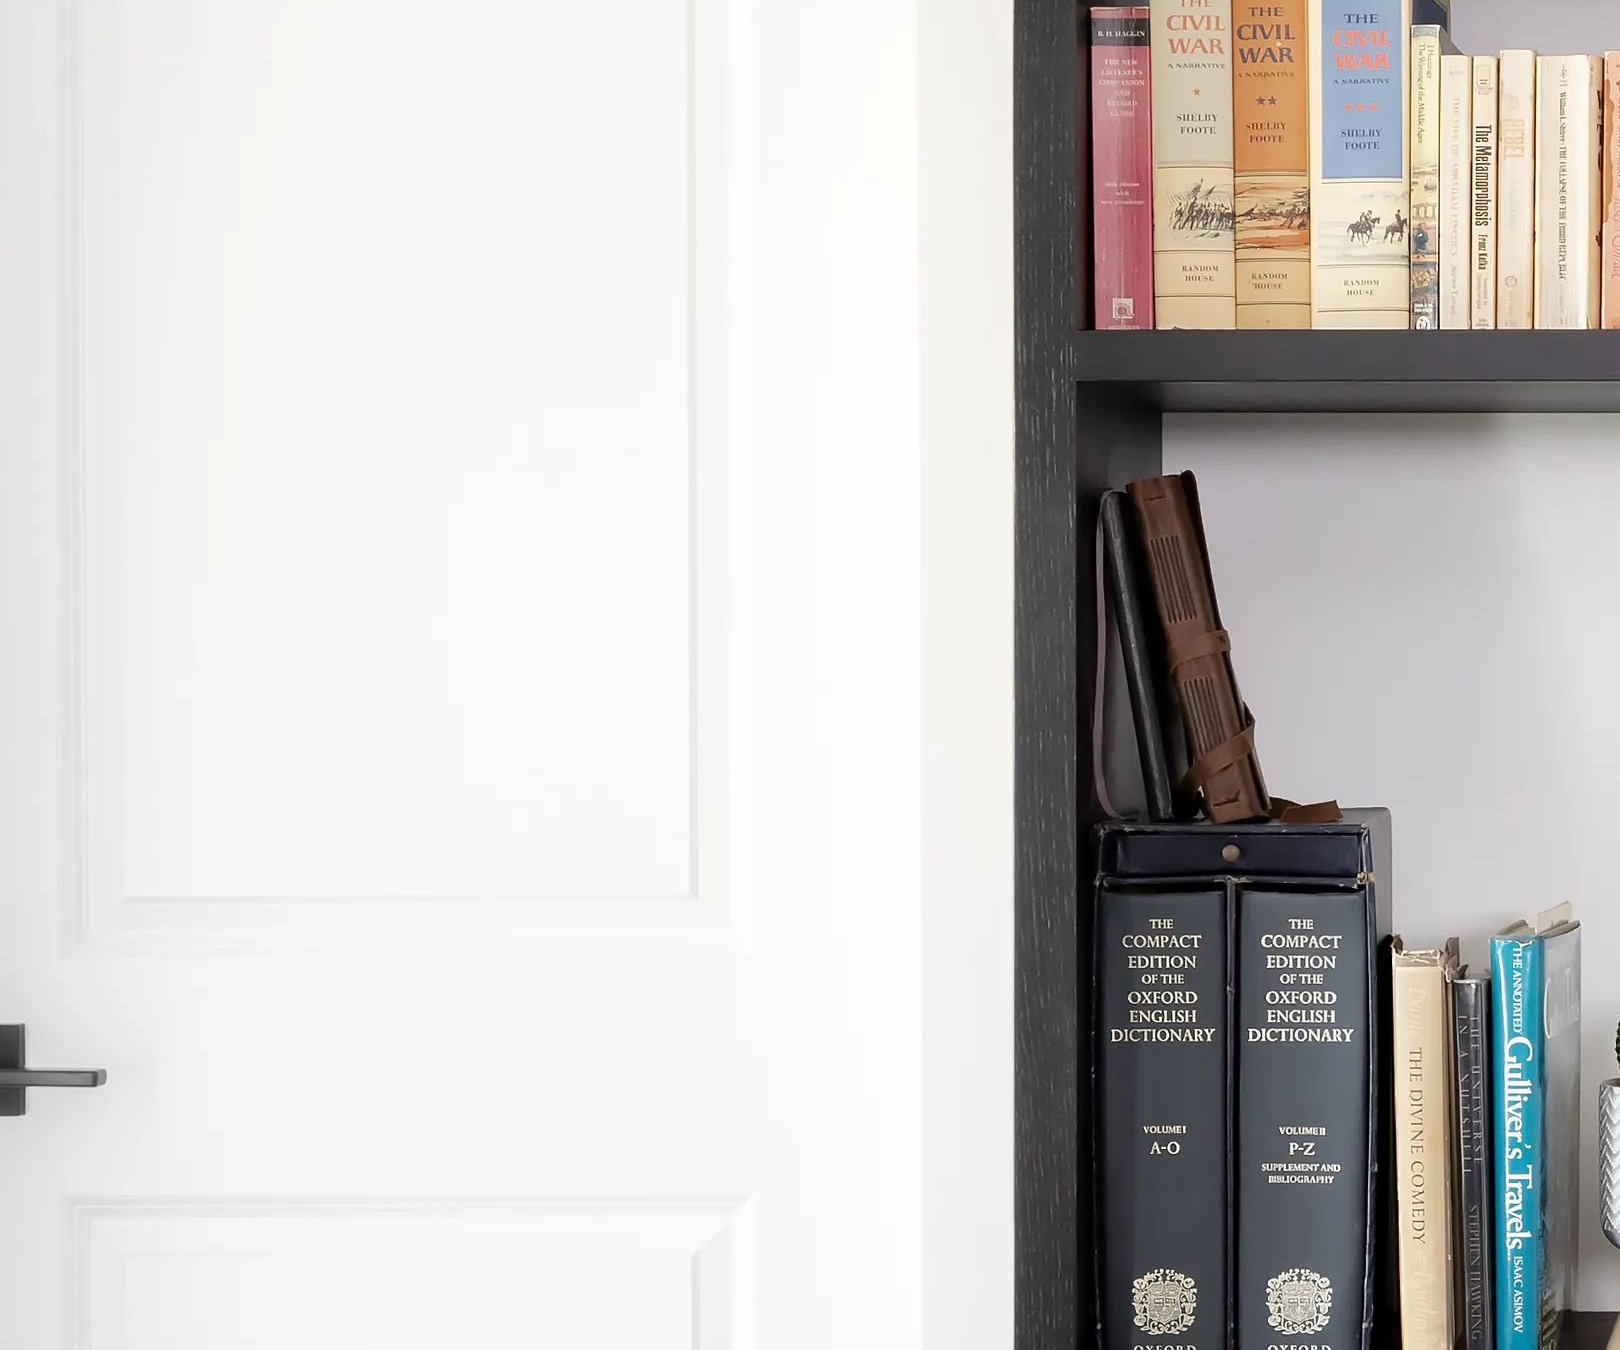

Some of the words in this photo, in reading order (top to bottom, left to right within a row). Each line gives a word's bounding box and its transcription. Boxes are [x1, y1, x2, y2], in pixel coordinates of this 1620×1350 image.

[1248, 7, 1283, 16] THE
[1167, 16, 1225, 31] CIVIL
[1237, 25, 1295, 40] CIVIL
[1168, 38, 1223, 54] WAR
[1239, 47, 1294, 63] WAR
[1177, 114, 1217, 122] SHELBY
[1180, 126, 1216, 134] FOOTE
[1476, 124, 1492, 143] The
[1475, 146, 1492, 226] Metamorphosis
[1150, 919, 1173, 929] THE
[1122, 934, 1201, 950] COMPACT
[1128, 954, 1197, 969] EDITION
[1141, 973, 1157, 984] OF
[1161, 973, 1184, 984] THE
[1127, 990, 1198, 1006] OXFORD
[1129, 1010, 1196, 1024] ENGLISH
[1110, 1027, 1215, 1042] DICTIONARY
[1505, 1036, 1532, 1161] Gulliver's
[1150, 1141, 1180, 1155] A-O
[1289, 1142, 1315, 1156] P-Z
[1505, 1166, 1533, 1251] Travels
